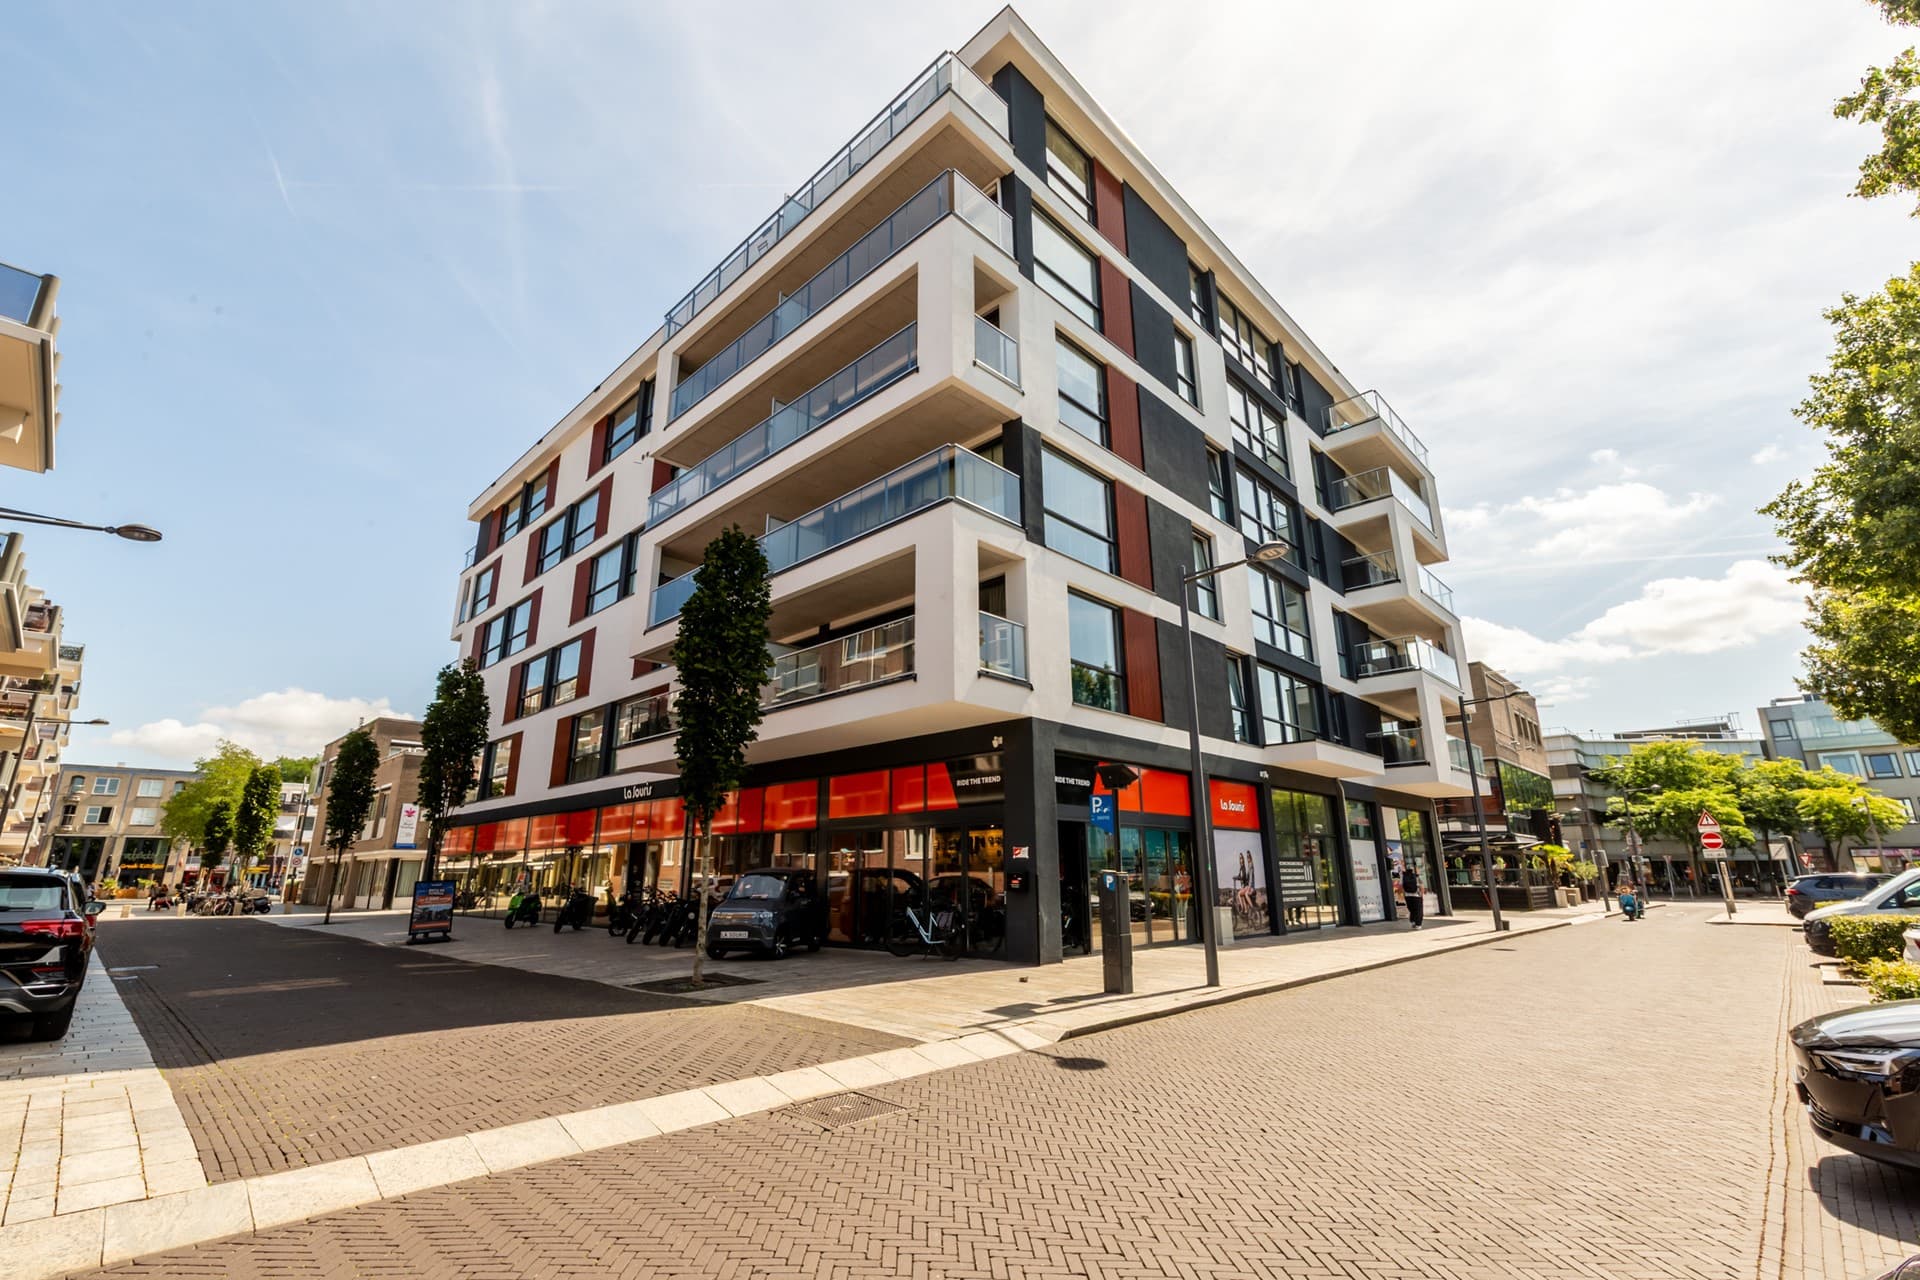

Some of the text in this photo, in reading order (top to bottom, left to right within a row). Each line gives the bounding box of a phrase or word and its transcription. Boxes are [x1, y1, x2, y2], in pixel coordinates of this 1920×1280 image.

[981, 775, 1001, 784] TREND
[1055, 776, 1091, 787] RIDE THE TREND
[624, 782, 652, 800] La Souris
[1092, 797, 1102, 813] P
[1220, 799, 1228, 810] La
[1106, 875, 1113, 888] P
